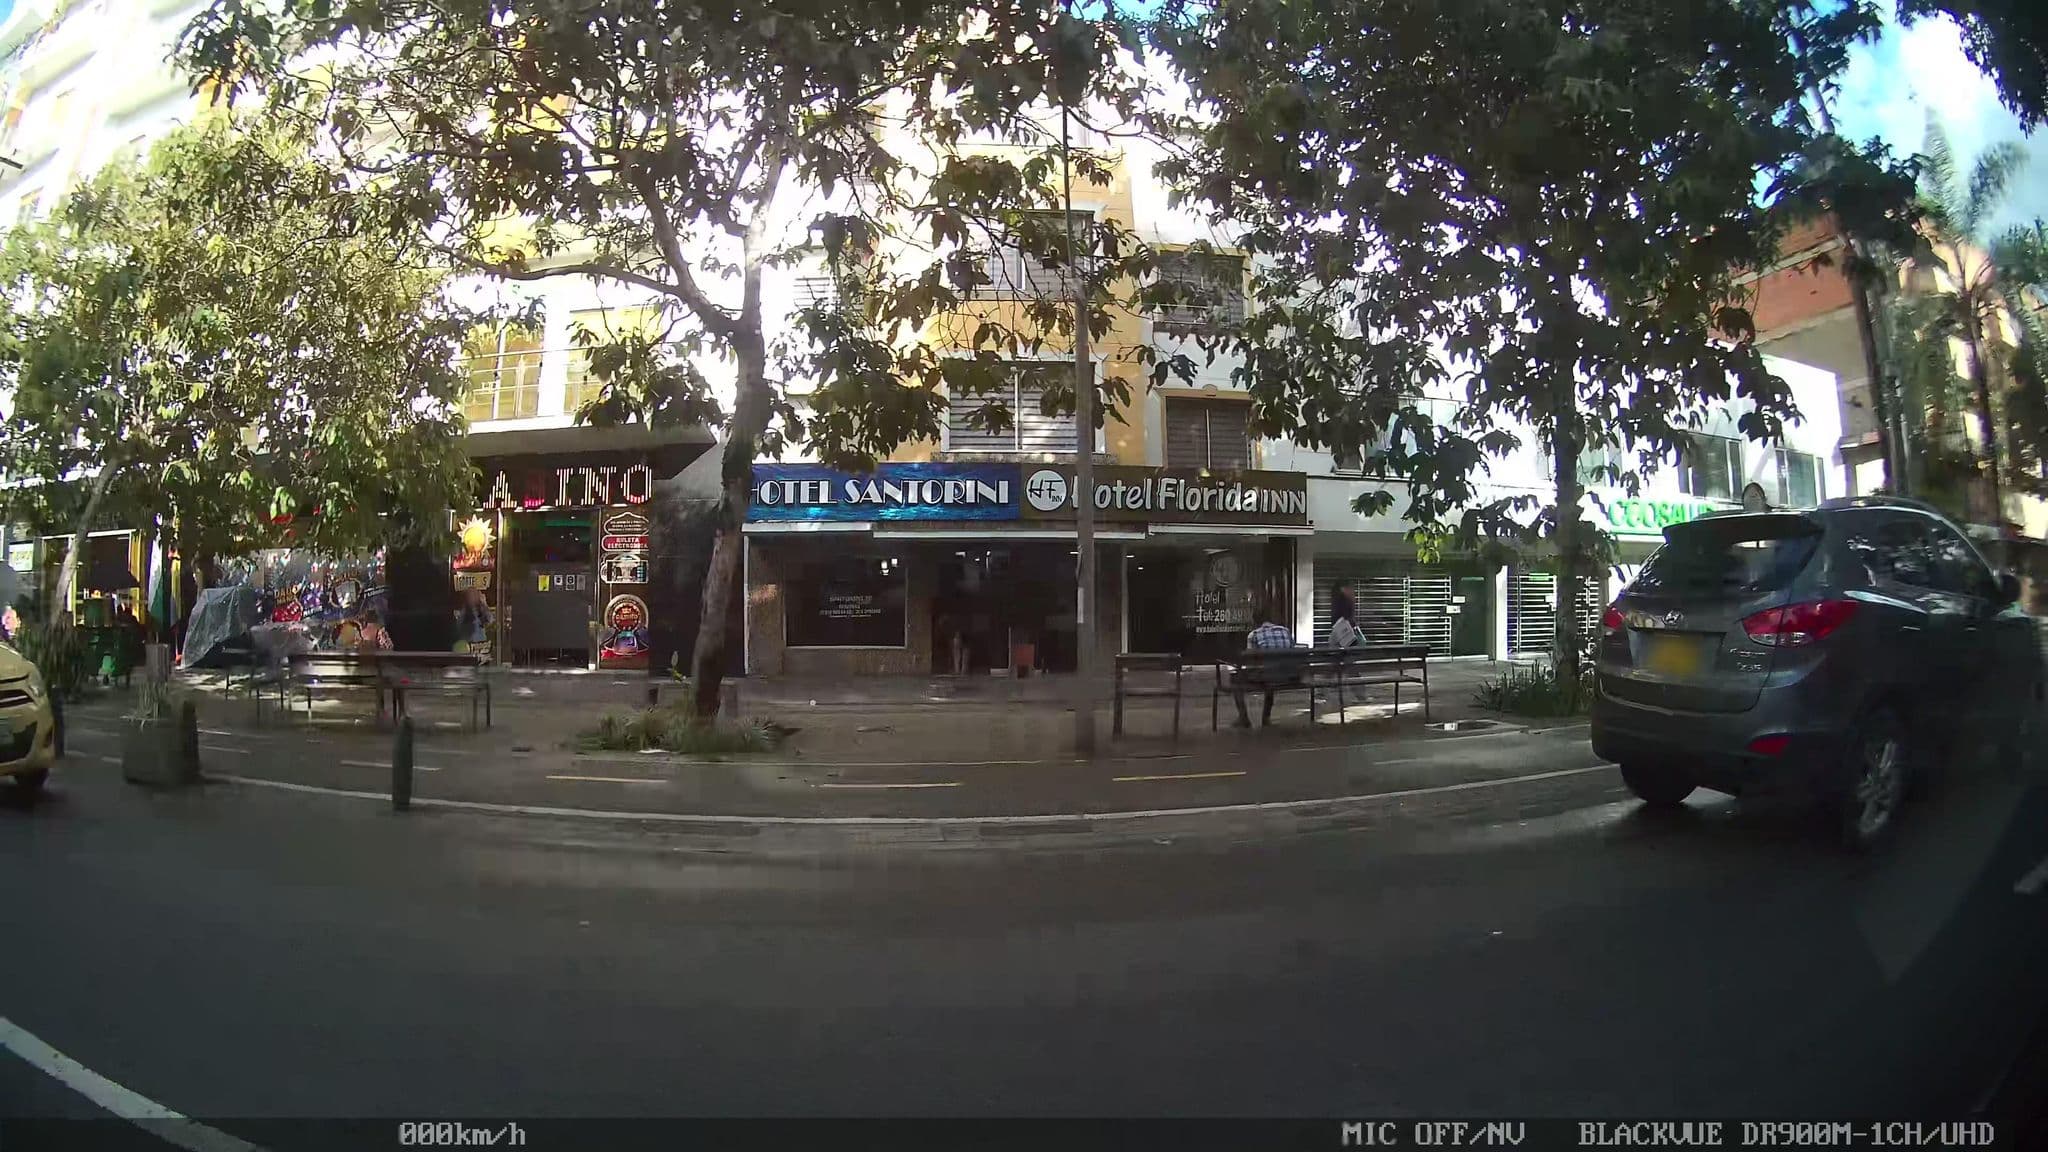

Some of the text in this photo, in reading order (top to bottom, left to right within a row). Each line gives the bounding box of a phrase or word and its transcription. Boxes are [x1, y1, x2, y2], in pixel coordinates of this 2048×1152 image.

[844, 479, 1009, 506] SANTORINI
[1158, 477, 1257, 512] Florida
[1260, 487, 1307, 514] INN
